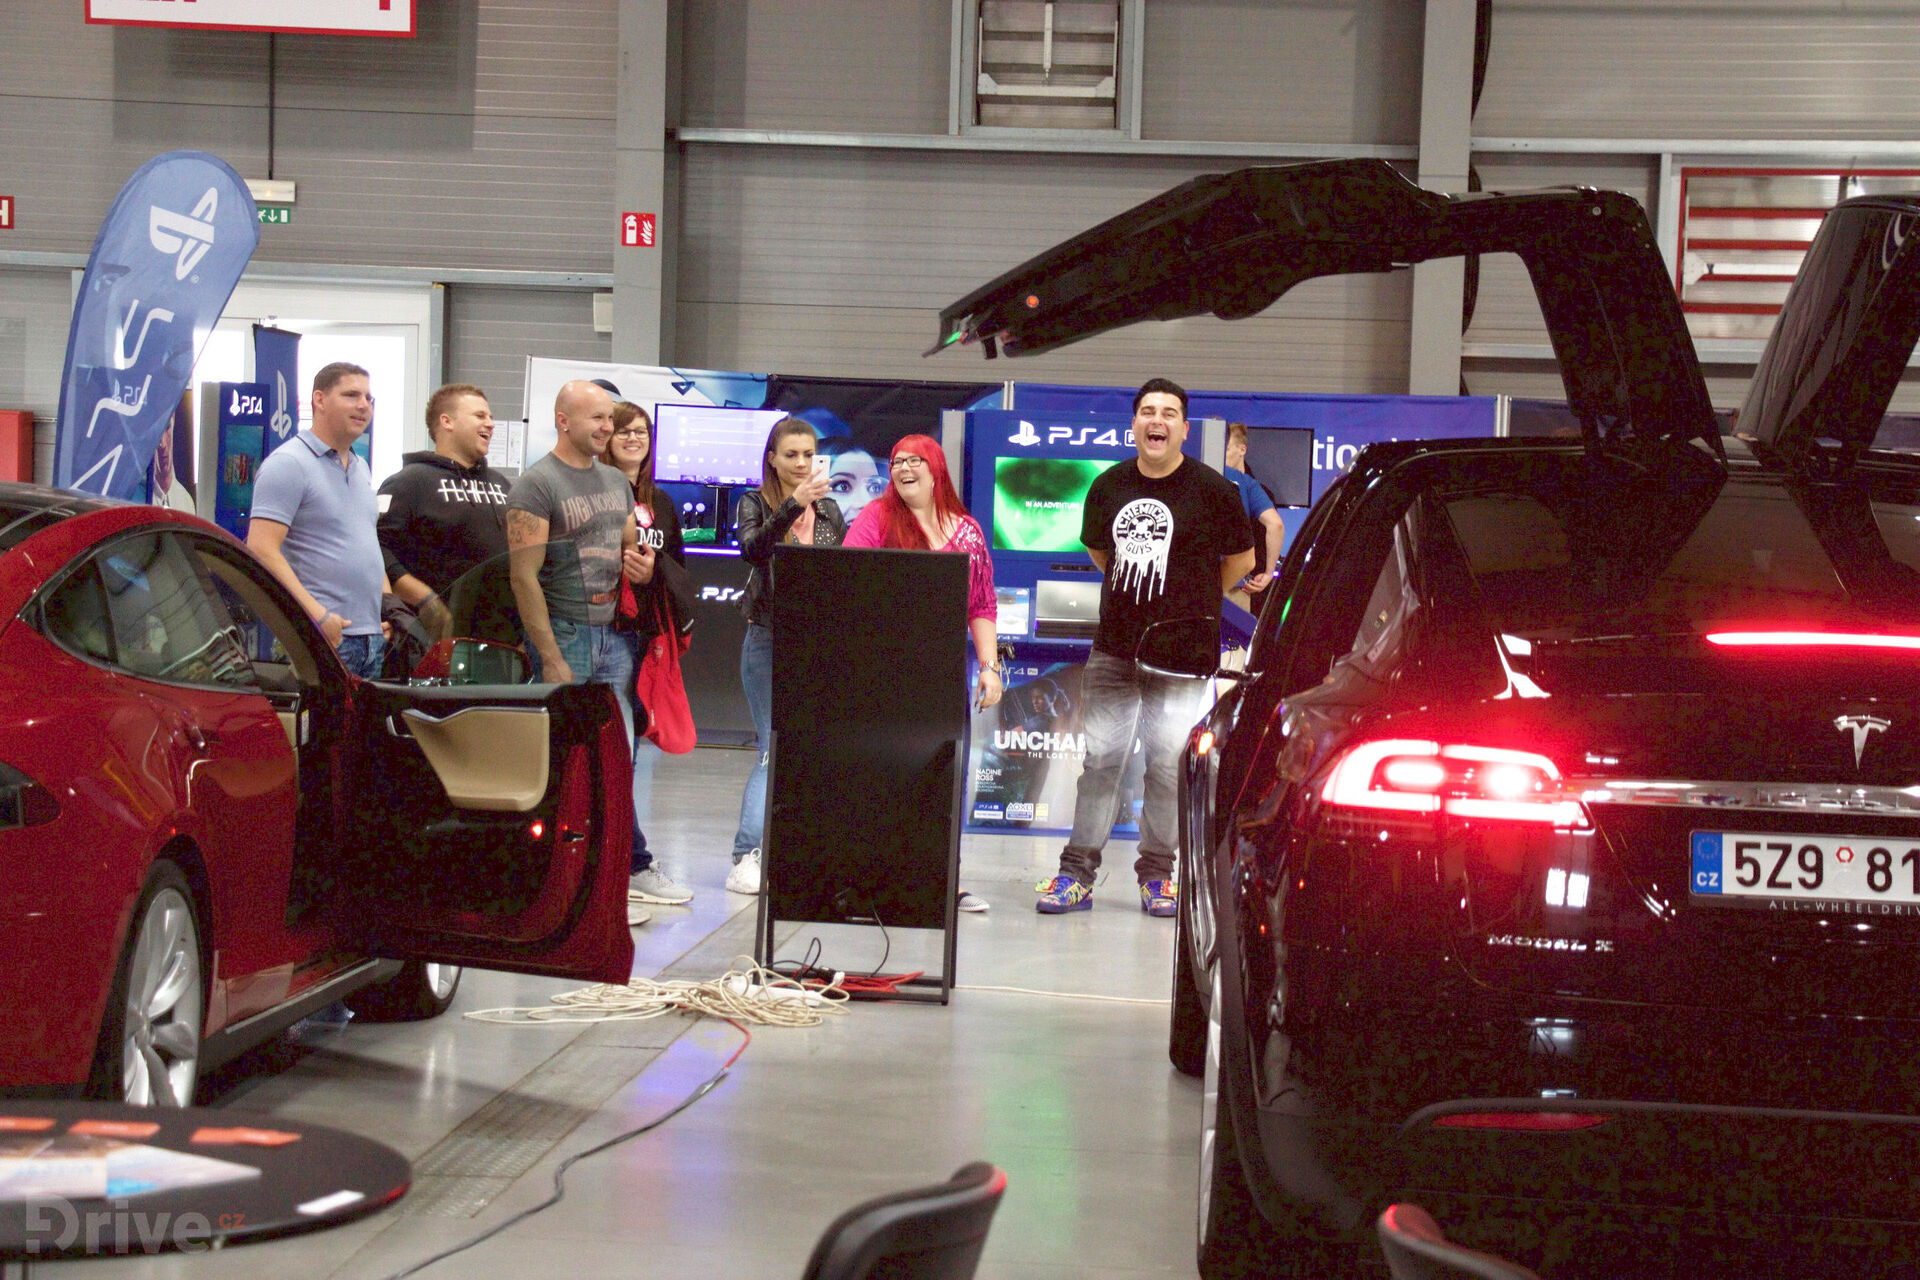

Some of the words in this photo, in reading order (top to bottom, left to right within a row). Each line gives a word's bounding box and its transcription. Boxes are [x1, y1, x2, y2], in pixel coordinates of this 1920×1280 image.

[241, 395, 263, 415] PS4
[1048, 426, 1120, 447] PS4
[1117, 503, 1168, 532] CHEMICAL
[1125, 542, 1153, 555] GUYS
[1027, 751, 1043, 759] THE
[1046, 752, 1069, 760] LOST
[975, 768, 1002, 776] NADINE
[975, 774, 994, 782] ROSS
[1696, 872, 1720, 888] CZ
[1735, 841, 1824, 890] 5Z9
